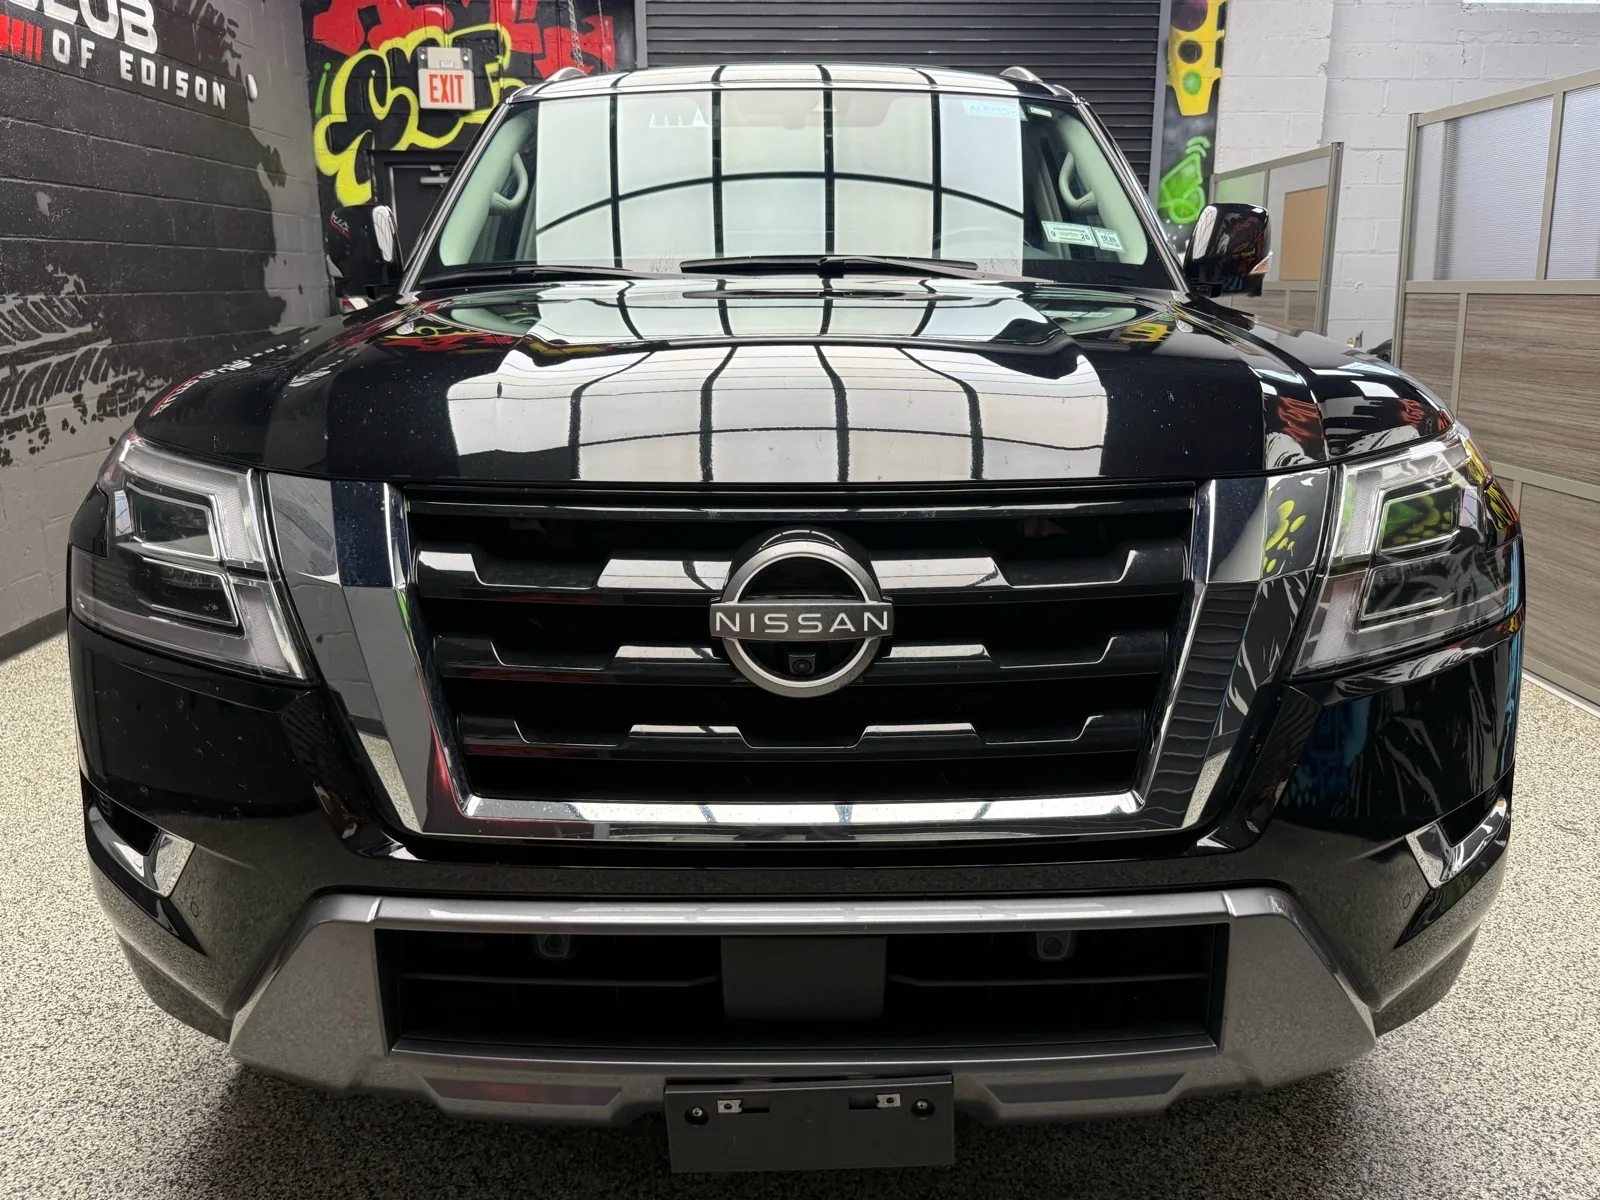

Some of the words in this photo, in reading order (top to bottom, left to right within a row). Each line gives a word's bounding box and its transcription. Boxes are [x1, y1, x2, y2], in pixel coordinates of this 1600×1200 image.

[52, 28, 95, 68] OF
[119, 50, 226, 110] EDISON
[429, 73, 464, 104] EXIT
[715, 611, 888, 633] NISSAN
